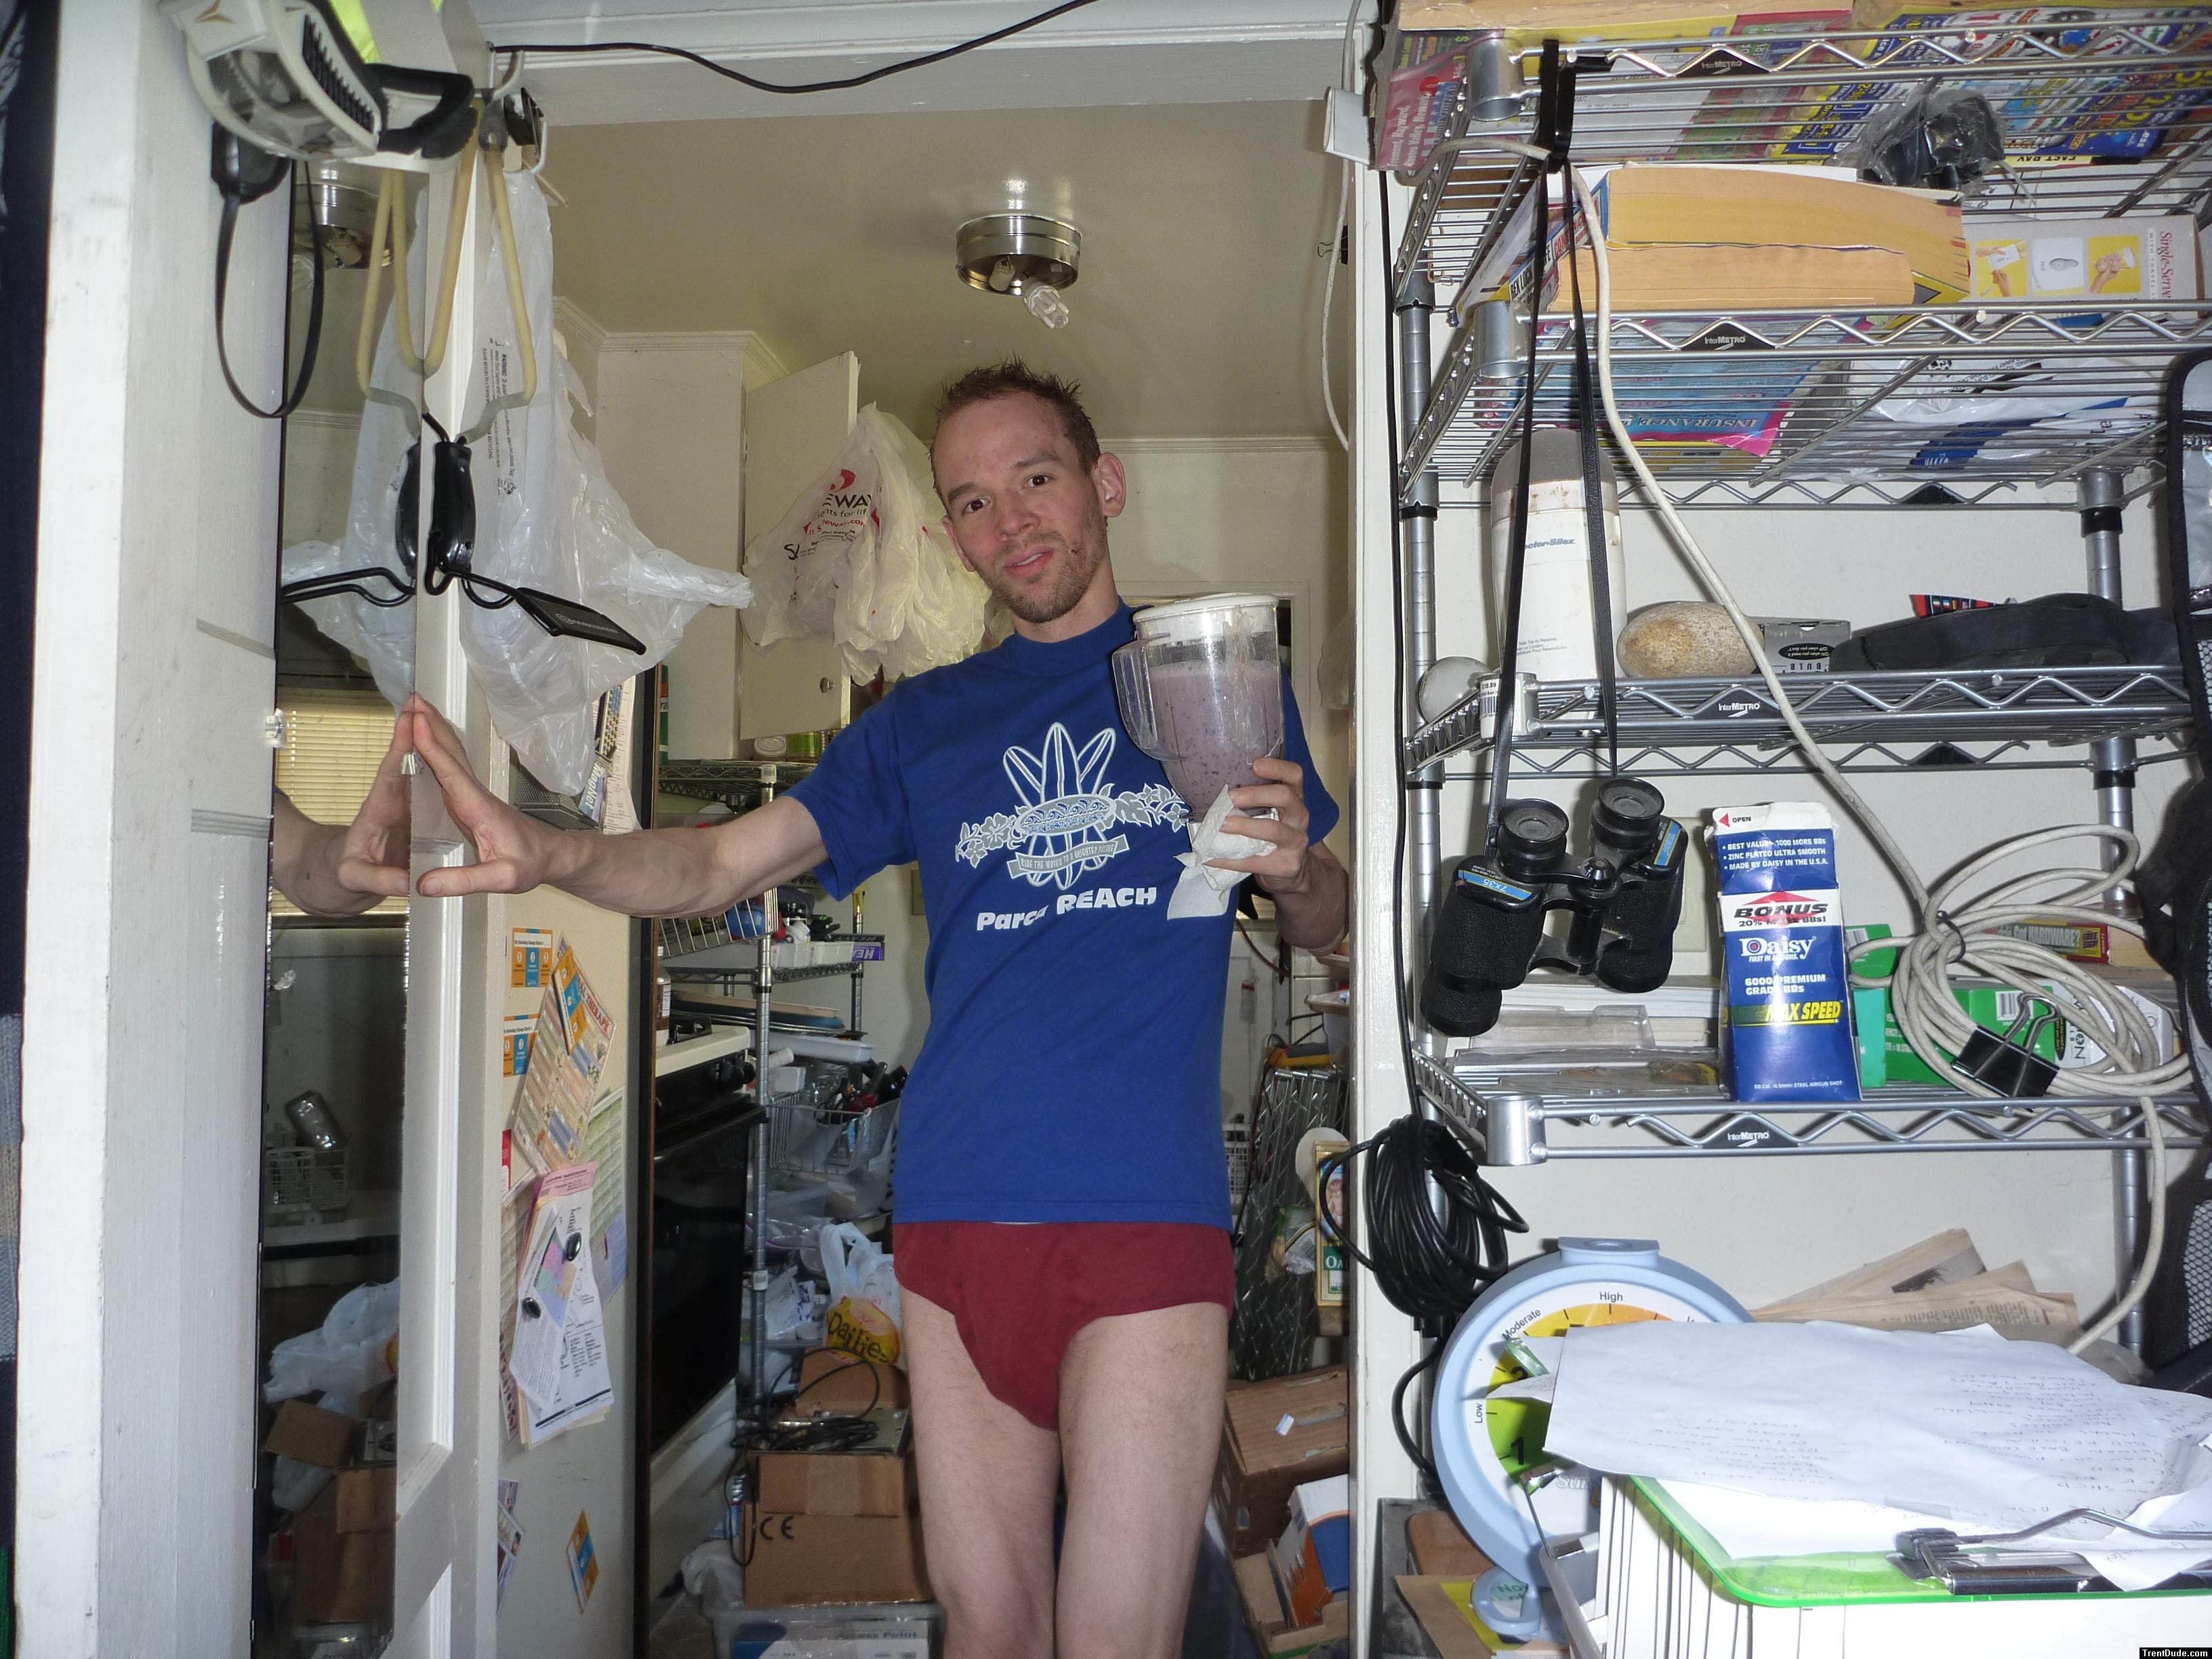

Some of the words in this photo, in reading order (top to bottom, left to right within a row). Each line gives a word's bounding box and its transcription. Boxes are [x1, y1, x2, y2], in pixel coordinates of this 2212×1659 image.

[1702, 60, 1742, 69] InterMETRO
[1704, 335, 1746, 344] InterMETRO
[1637, 417, 1759, 429] INSURANCE
[1719, 702, 1761, 711] InterMETRO
[585, 762, 604, 810] MagNet
[1727, 842, 1744, 851] BEST
[1021, 857, 1033, 868] RIDE
[1033, 859, 1044, 869] THE
[1045, 858, 1063, 869] WAVES
[1063, 855, 1070, 863] TO
[1074, 846, 1098, 859] BRIGHTER
[1098, 843, 1115, 854] FUTURE
[1746, 850, 1772, 859] PLATED
[1057, 886, 1157, 915] REACH
[1734, 903, 1828, 918] BONUS
[2028, 925, 2081, 947] HARDWARE?
[1739, 936, 1814, 960] Daisy
[1744, 977, 1773, 986] 6000
[1778, 974, 1826, 984] PREMIUM
[1801, 1000, 1841, 1020] SPEED
[1727, 1132, 1769, 1141] InterMETRO
[1599, 1291, 1623, 1302] High
[1501, 1309, 1542, 1341] Moderate
[1474, 1402, 1483, 1424] Low
[1511, 1436, 1525, 1465] 1
[884, 1630, 918, 1638] Point
